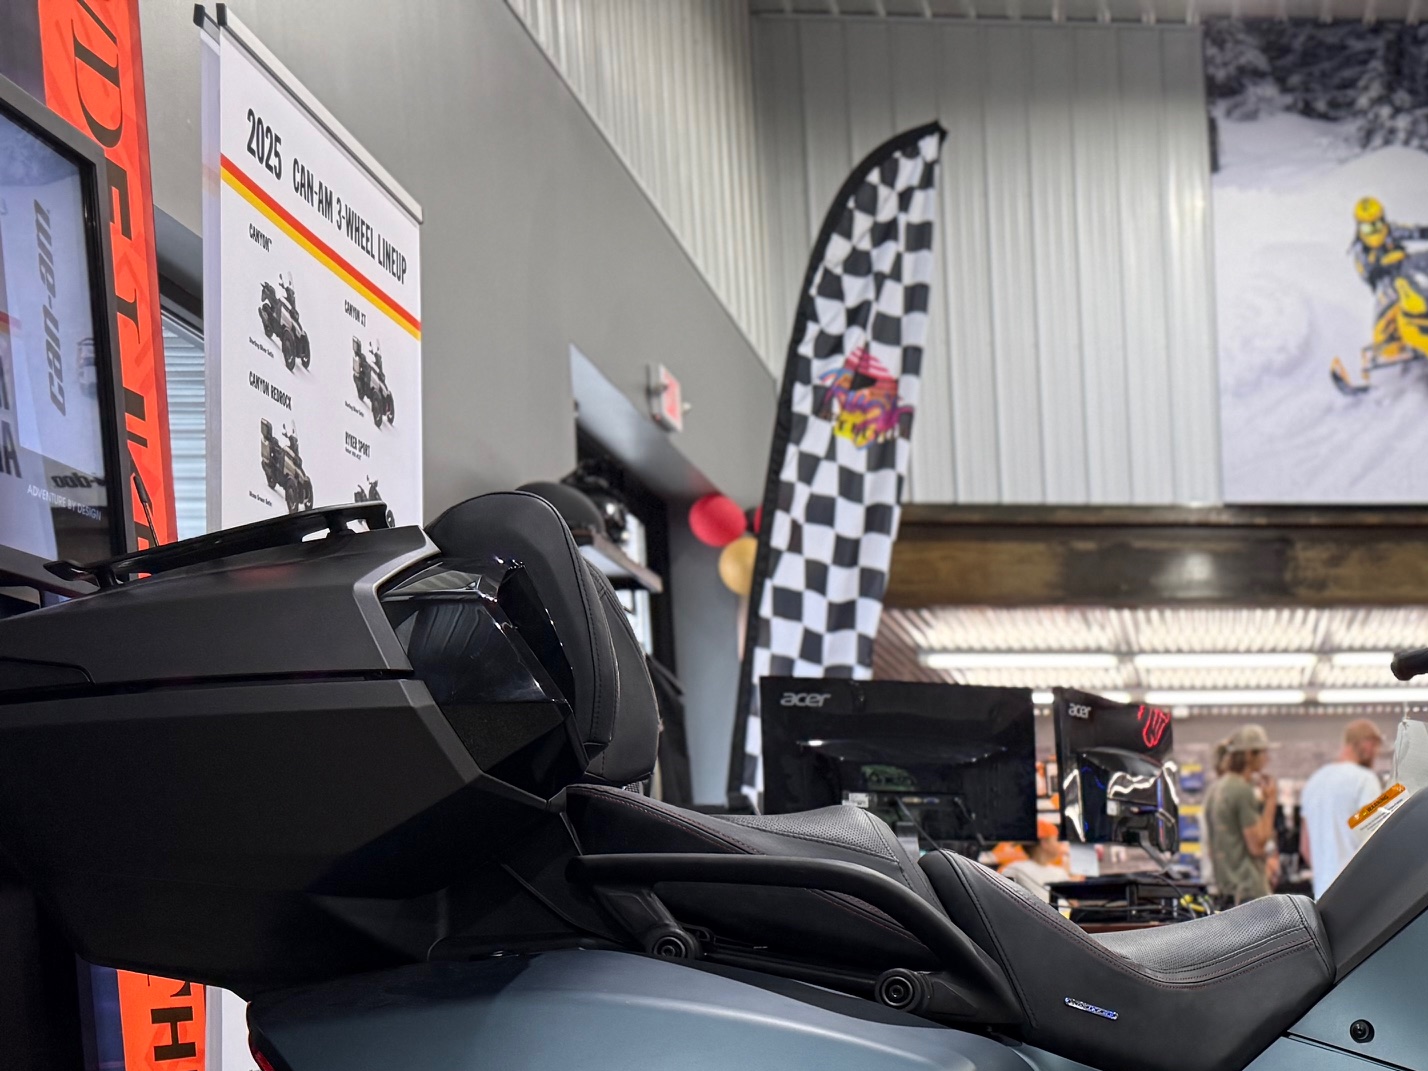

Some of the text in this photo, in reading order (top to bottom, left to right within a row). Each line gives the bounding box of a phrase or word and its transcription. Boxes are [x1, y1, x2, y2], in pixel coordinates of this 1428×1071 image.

[246, 107, 407, 285] 2025 CAN-AM 3-WHEEL LINEUP
[26, 483, 102, 522] ADVENTURE BY DESIGN
[780, 692, 832, 708] acer
[1068, 702, 1092, 719] acer
